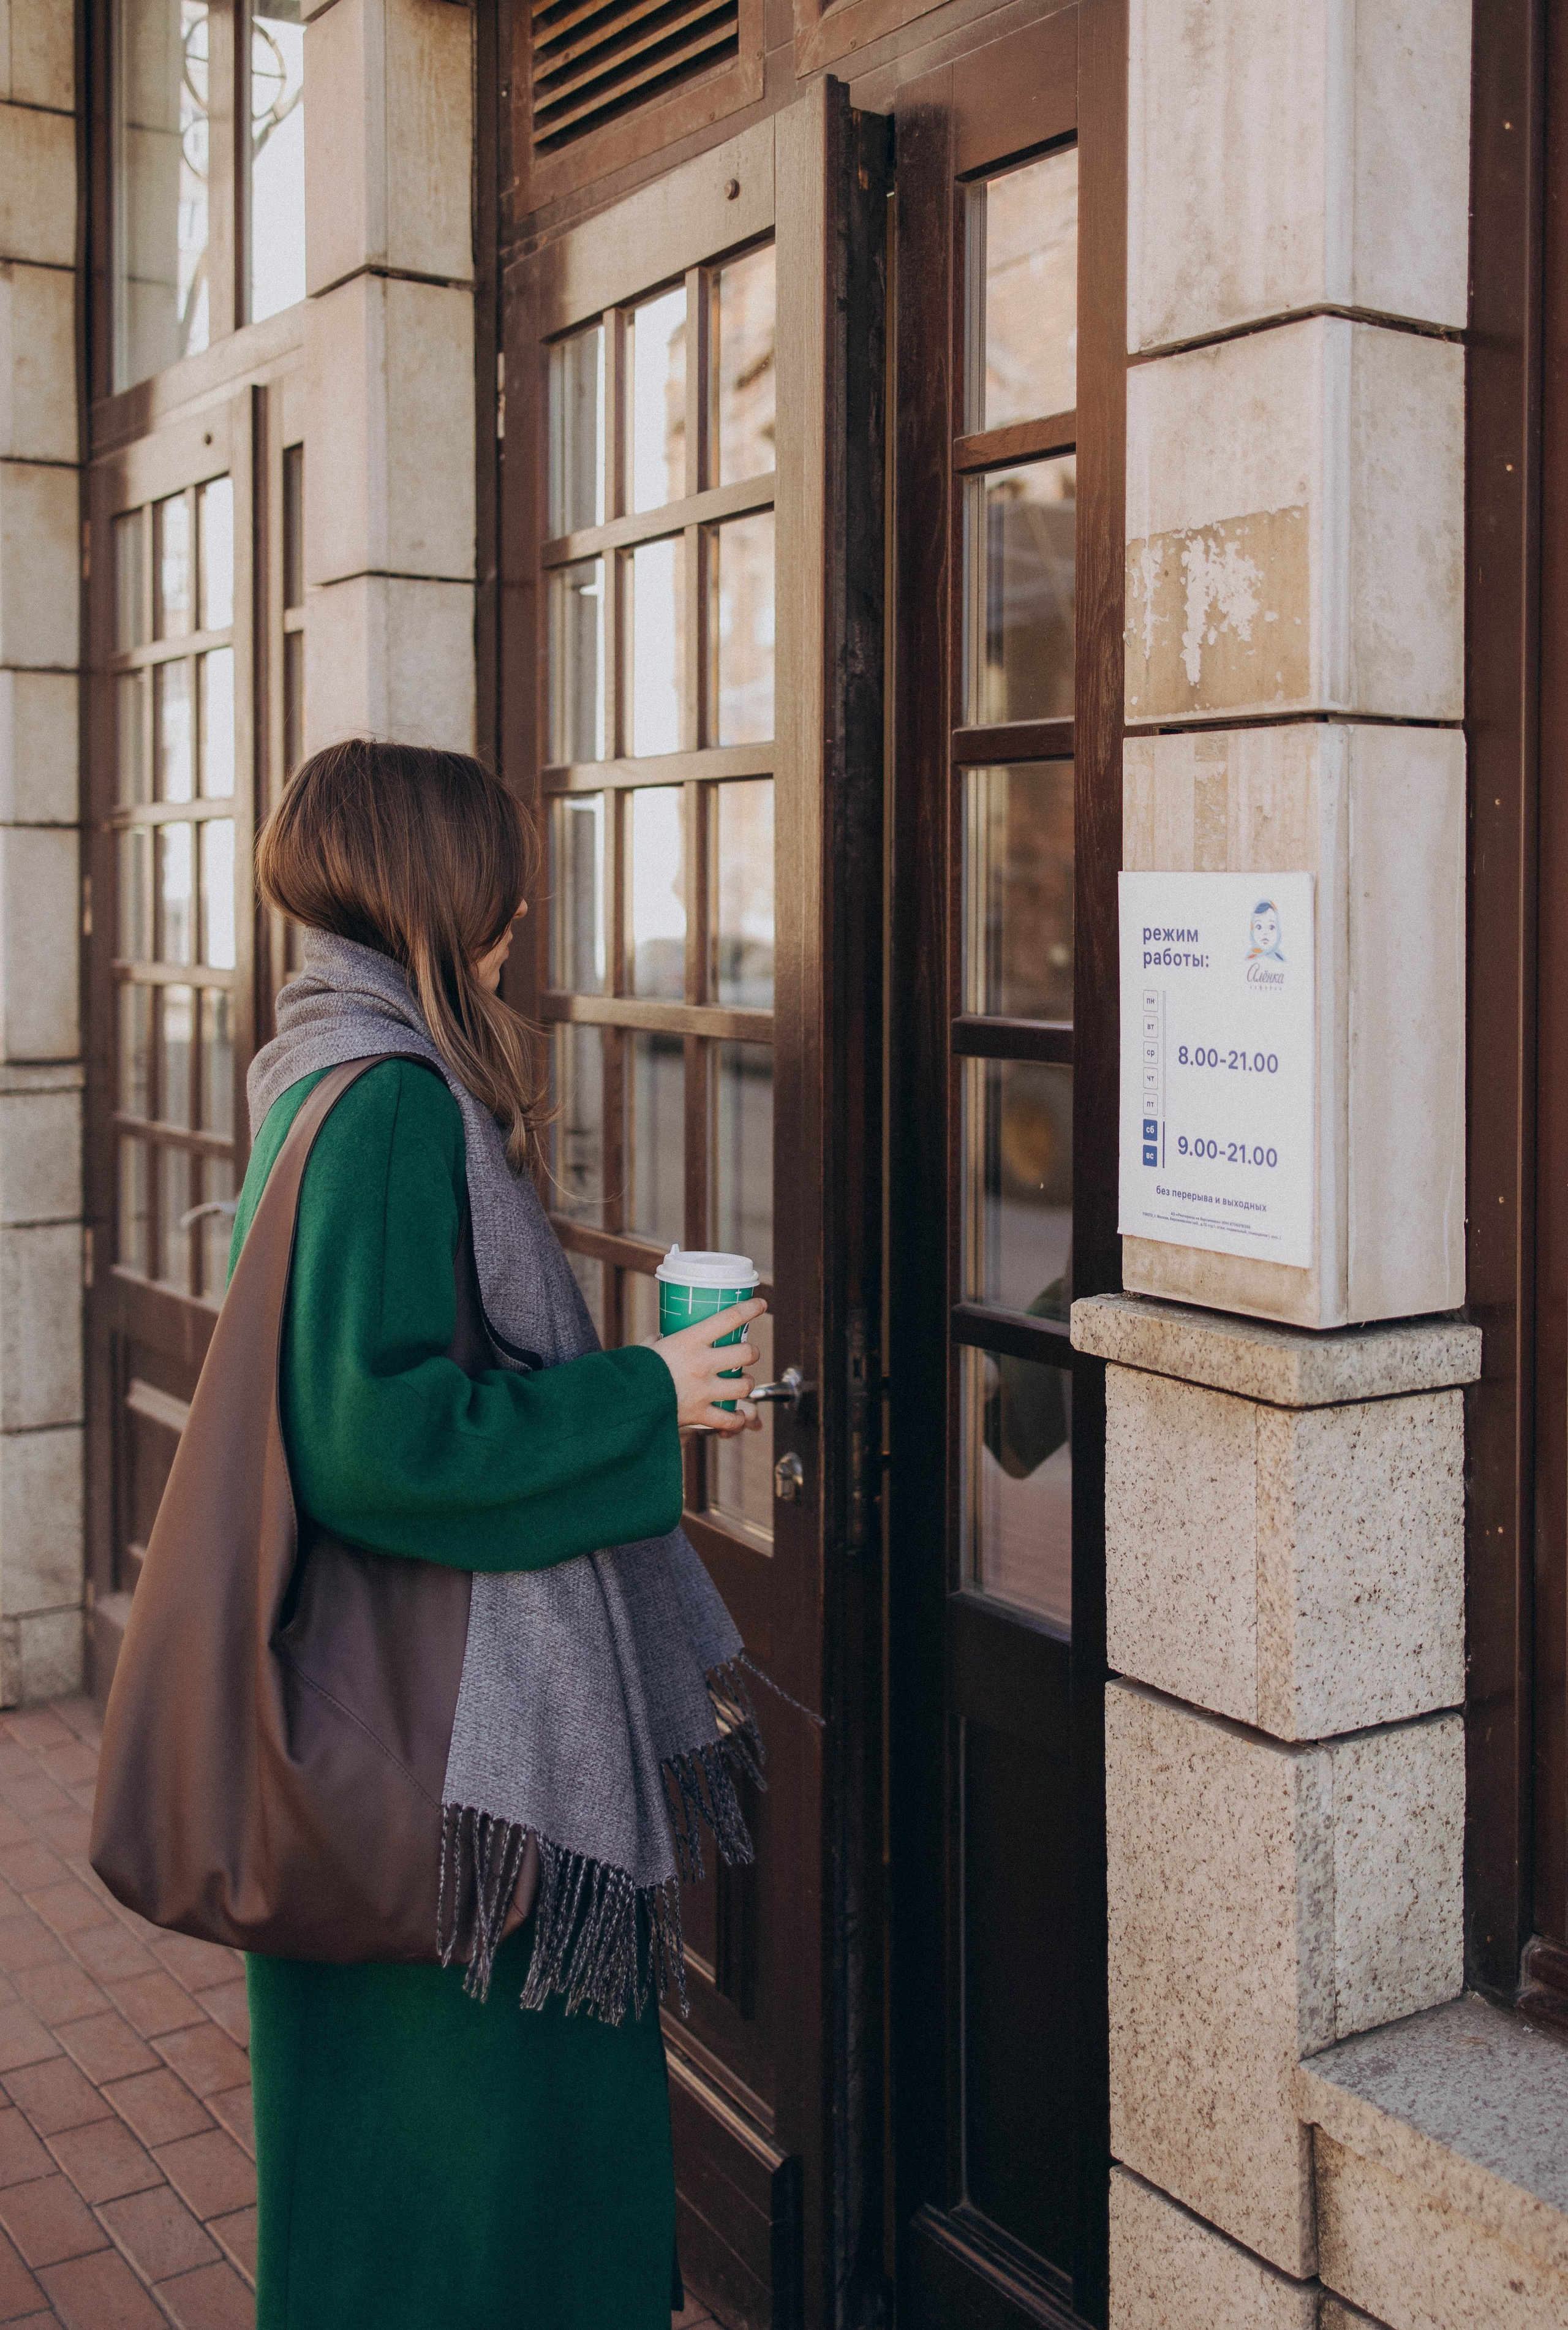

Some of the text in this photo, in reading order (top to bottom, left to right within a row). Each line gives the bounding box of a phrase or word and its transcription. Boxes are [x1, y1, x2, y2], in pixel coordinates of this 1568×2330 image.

[1143, 927, 1198, 945] режим
[1143, 948, 1209, 969] работы:
[1246, 963, 1284, 984] Алёнка
[1178, 1046, 1278, 1073] 8.00-21.00
[1178, 1136, 1278, 1168] 9.00-21.00
[1156, 1185, 1170, 1195] без
[1172, 1189, 1213, 1203] перерыва
[1223, 1198, 1267, 1212] выходных
